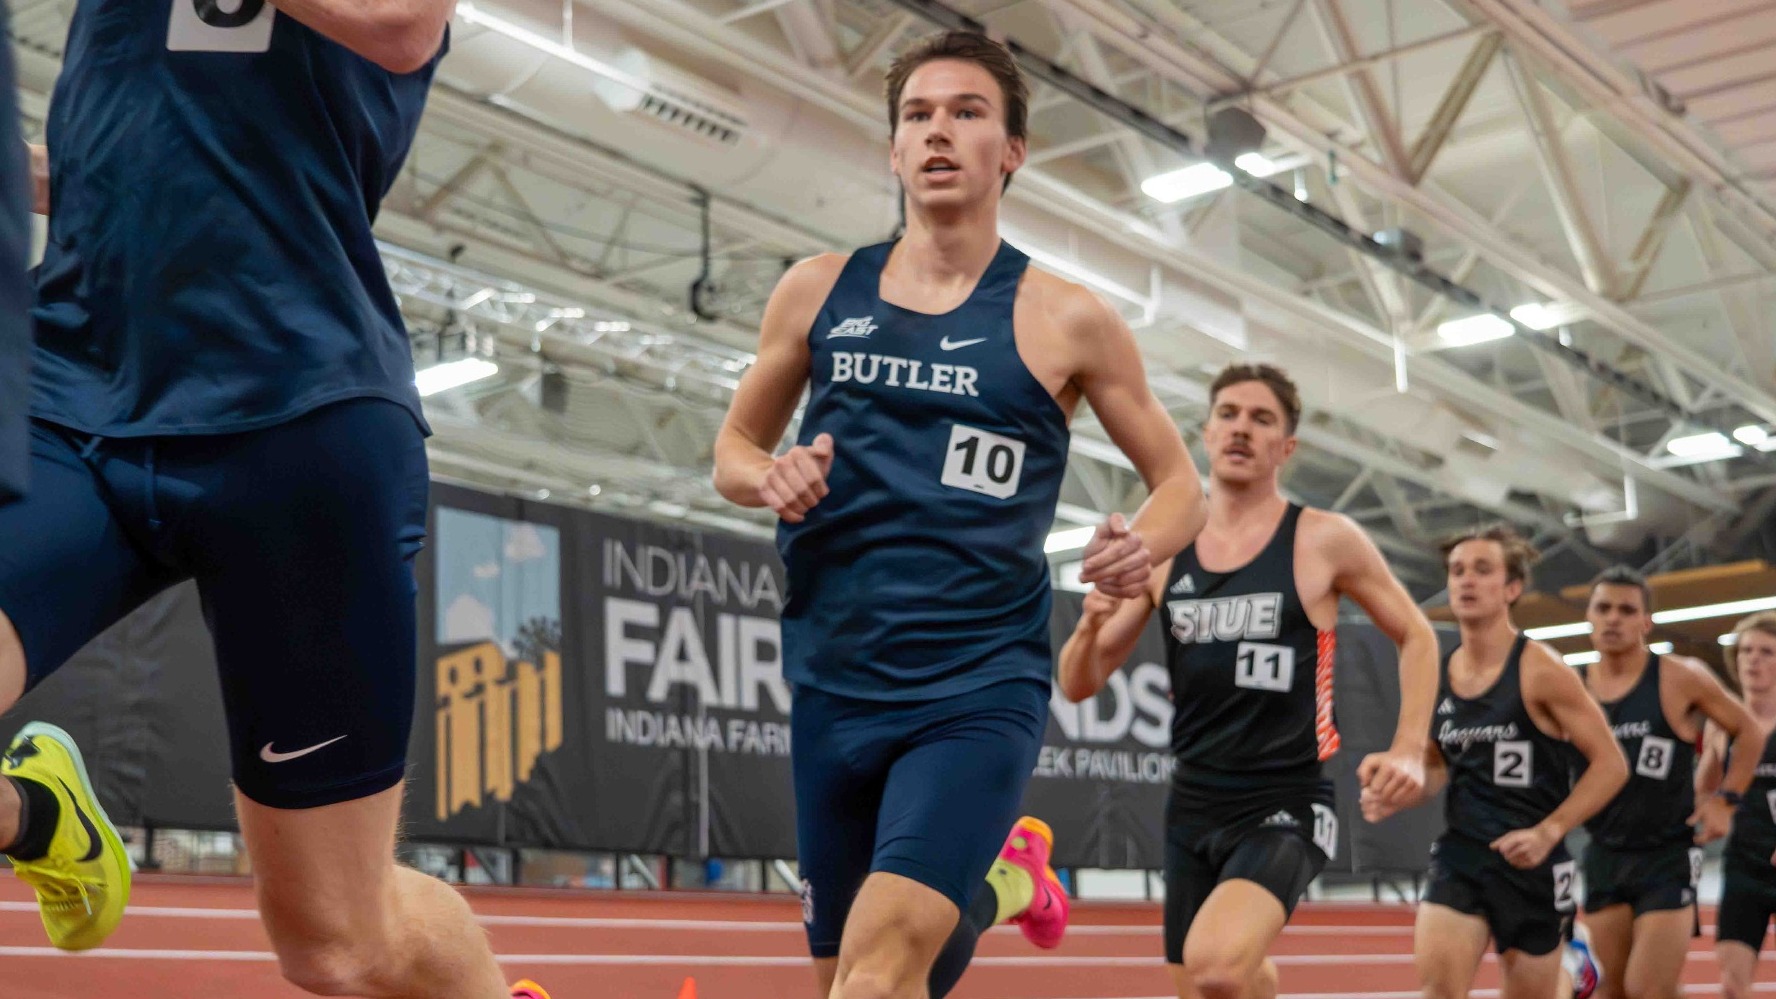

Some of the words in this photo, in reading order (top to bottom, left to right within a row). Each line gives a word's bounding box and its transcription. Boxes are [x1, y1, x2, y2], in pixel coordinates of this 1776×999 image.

[831, 351, 979, 397] BUTLER
[954, 436, 1015, 484] 10
[603, 538, 785, 613] INDIANA
[1166, 592, 1283, 644] SIUE
[1238, 649, 1280, 680] 11
[605, 708, 725, 750] INDIANA
[1438, 719, 1519, 753] Jaguars
[1499, 752, 1523, 778] 2
[1643, 746, 1663, 770] 8
[1559, 872, 1571, 901] 2
